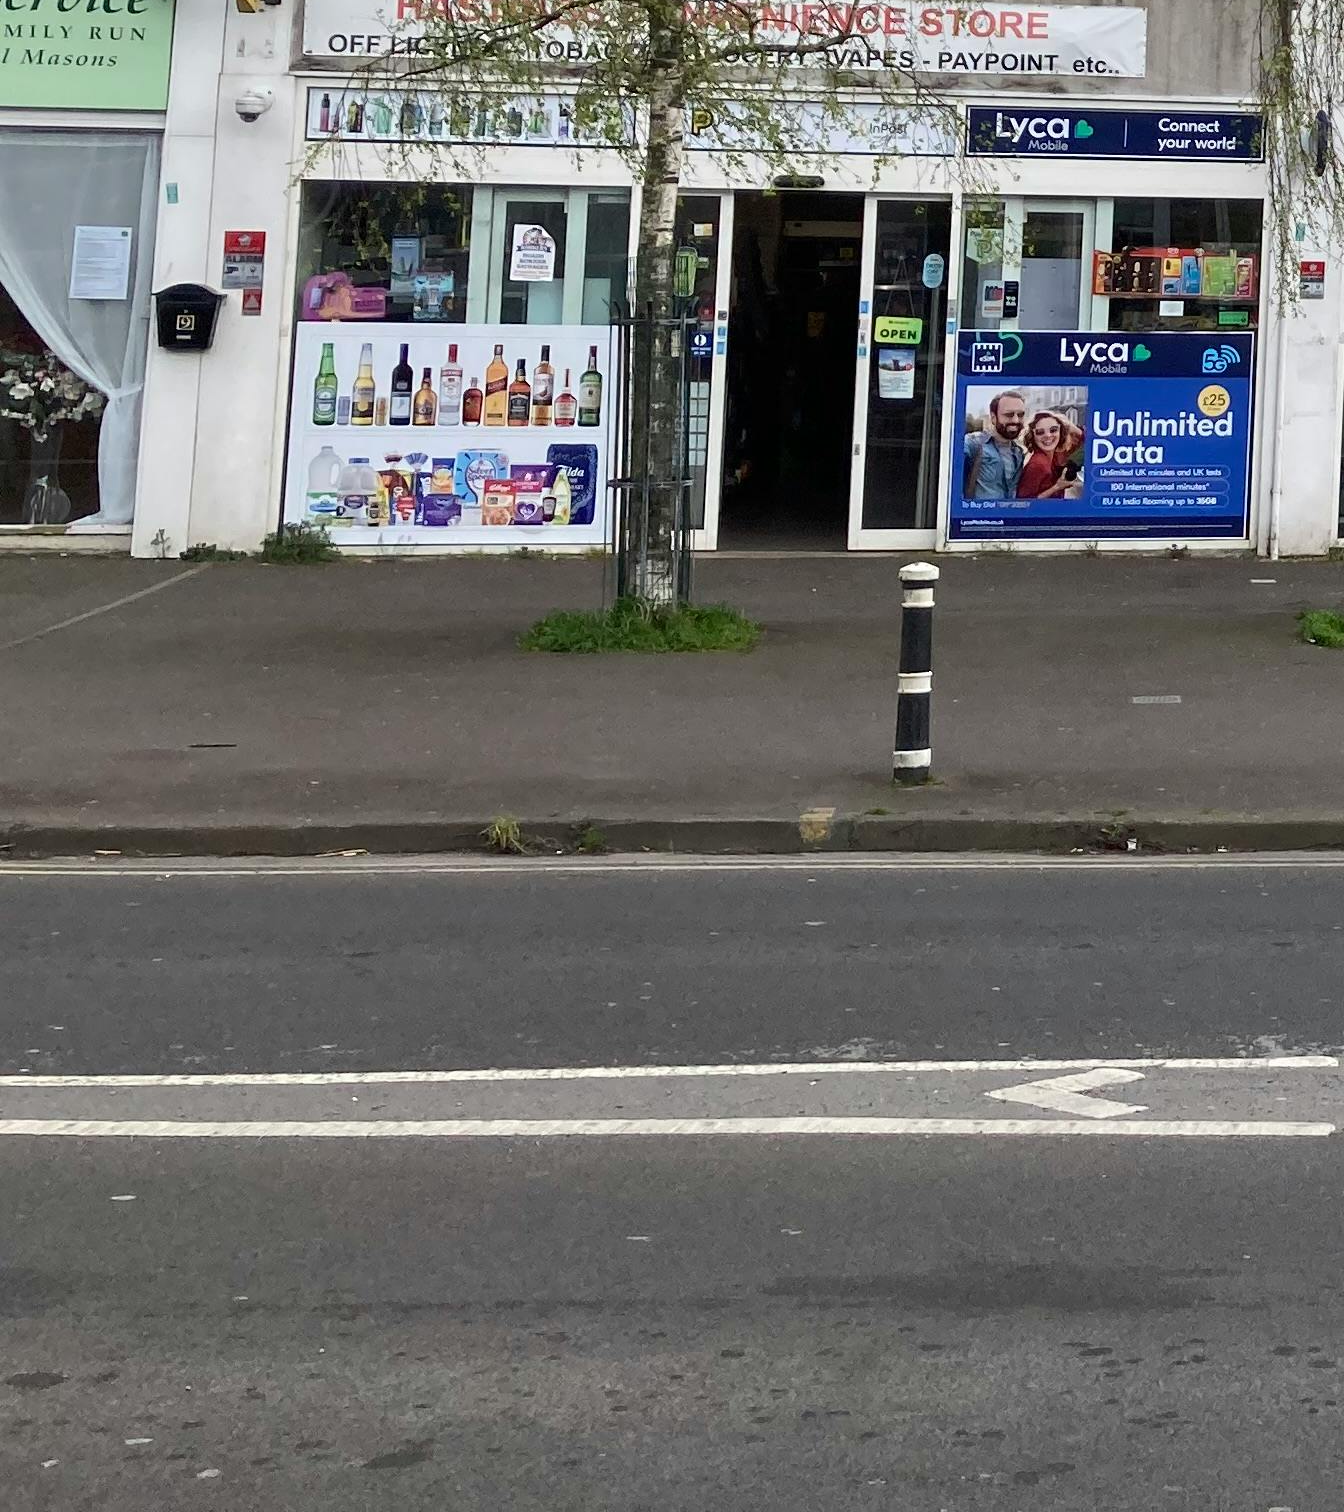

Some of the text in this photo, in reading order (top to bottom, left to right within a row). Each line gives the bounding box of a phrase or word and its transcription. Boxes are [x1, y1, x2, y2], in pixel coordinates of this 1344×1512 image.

[919, 9, 1049, 40] STORE
[90, 26, 147, 41] RUN
[21, 49, 118, 67] Masons
[328, 34, 380, 54] OFF
[834, 49, 914, 69] VAPES
[938, 53, 1059, 72] PAYPOINT
[996, 112, 1069, 142] Lyca
[1158, 117, 1220, 133] Connect
[1028, 139, 1069, 151] Mobile
[1158, 137, 1236, 151] your world
[180, 316, 191, 329] 9
[879, 328, 917, 339] OPEN
[1060, 338, 1128, 366] Lyca
[1090, 364, 1128, 374] Mobile
[1203, 393, 1226, 406] £25
[1093, 411, 1233, 437] Unlimited
[1092, 440, 1163, 464] Data
[1125, 483, 1175, 491] International
